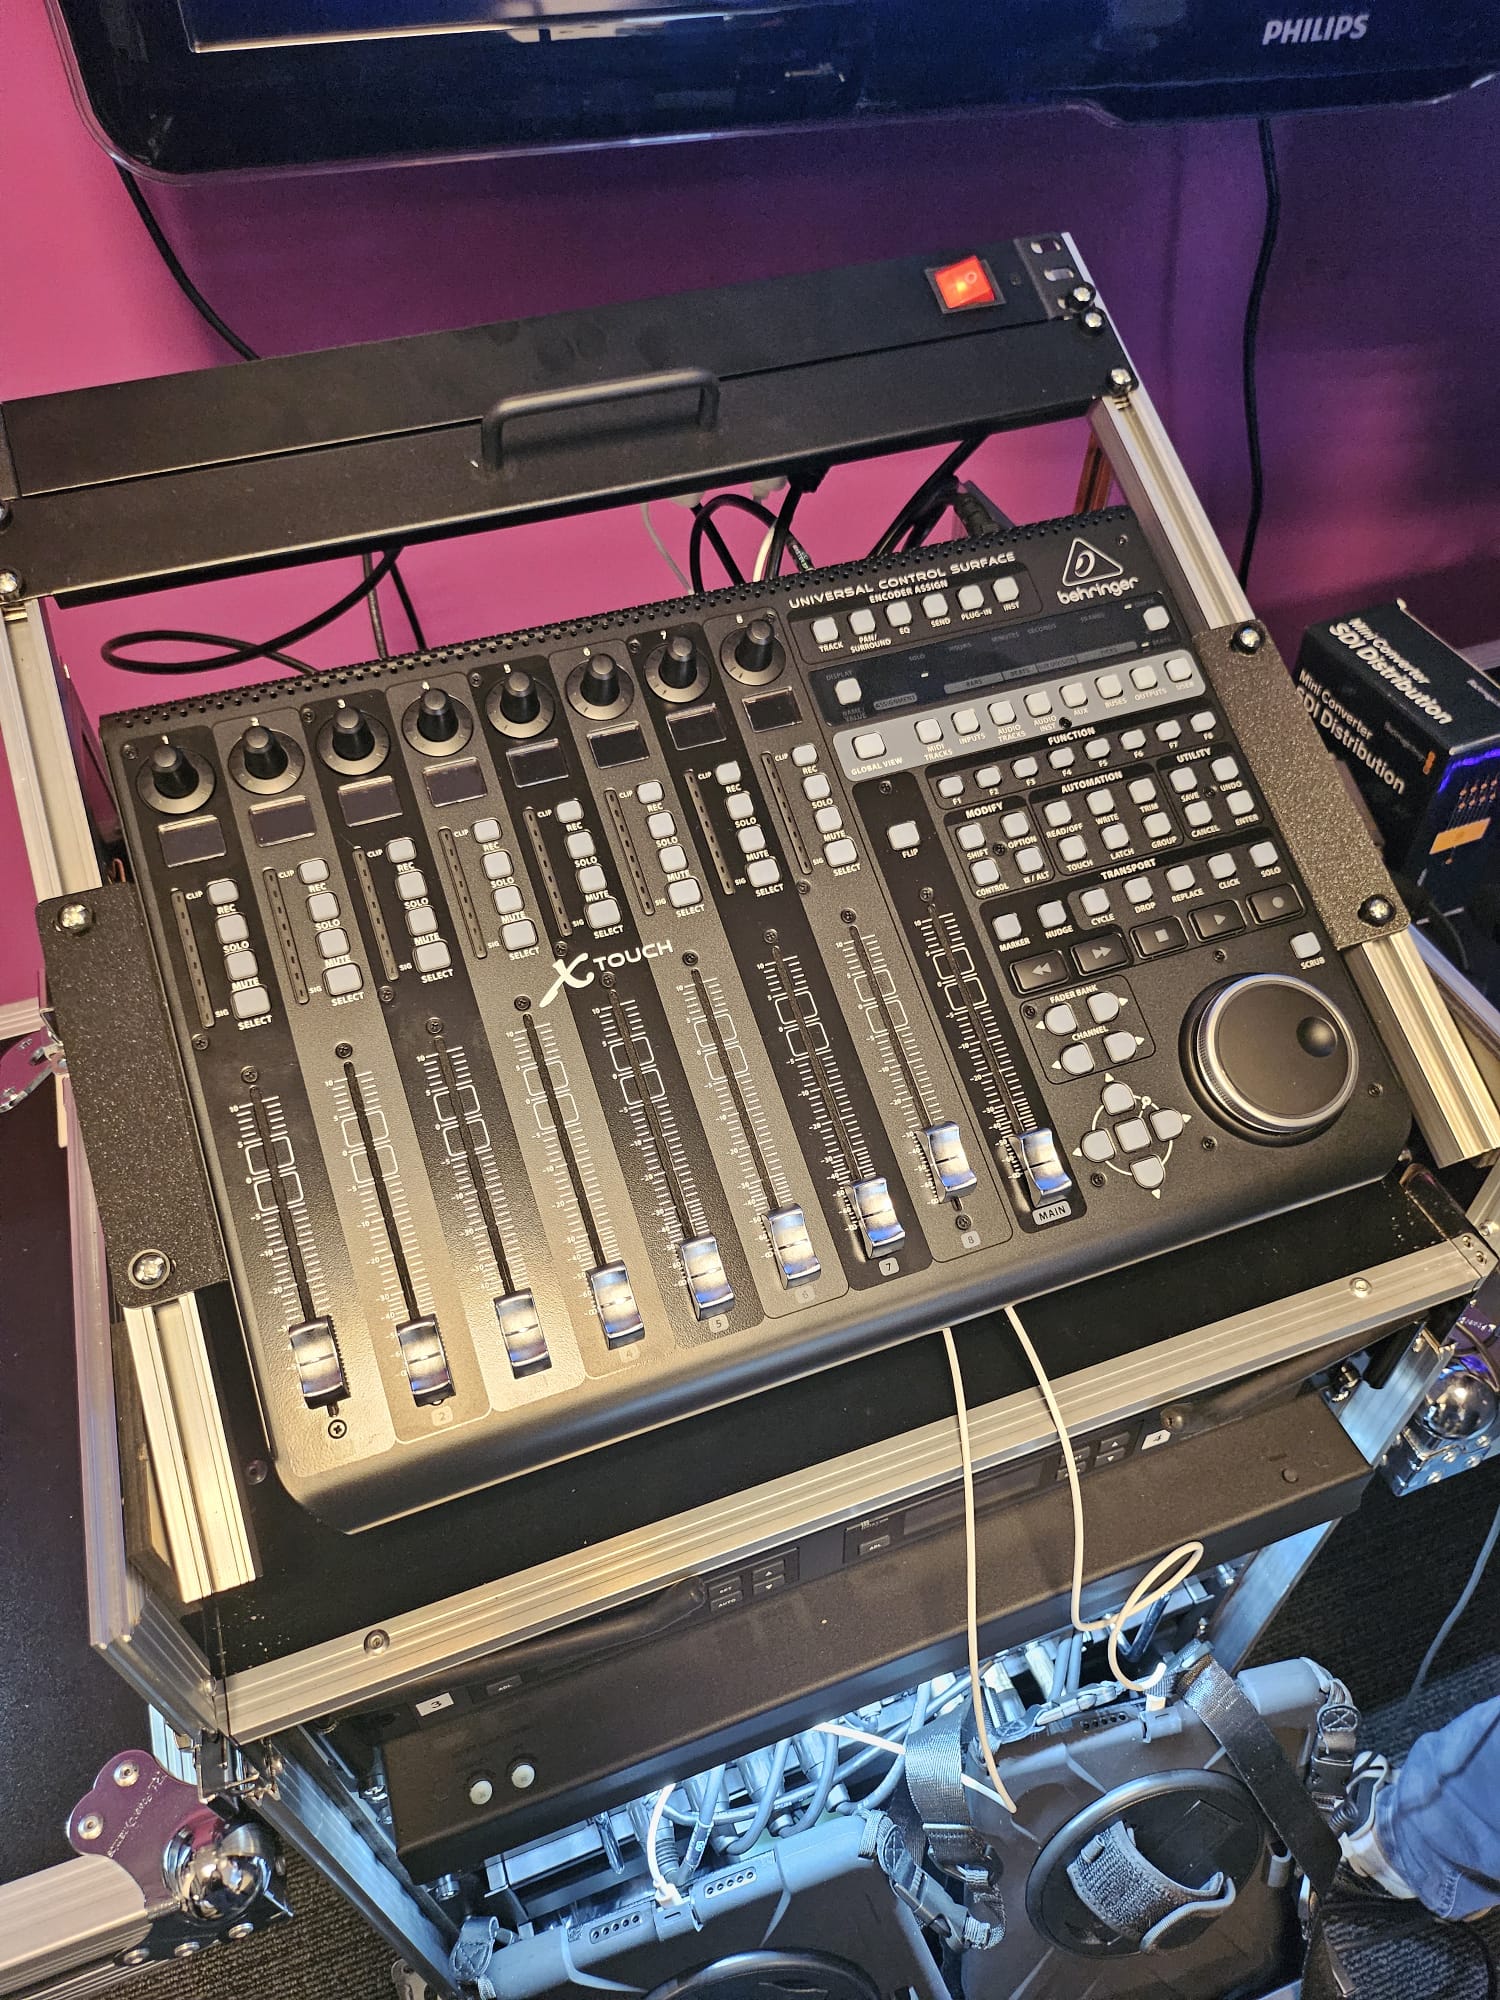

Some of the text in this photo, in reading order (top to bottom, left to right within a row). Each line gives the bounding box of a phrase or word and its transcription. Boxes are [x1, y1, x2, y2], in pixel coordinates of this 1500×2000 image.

[1262, 14, 1369, 45] PHILIPS
[789, 552, 1016, 609] UNIVERSAL CONTROL SURFACE
[869, 579, 948, 603] ENCODER ASSIGN
[1057, 577, 1139, 605] behringer
[1003, 601, 1019, 611] INST
[961, 608, 992, 621] PLUG-IN
[931, 618, 950, 628] SEND
[899, 627, 910, 635] EQ
[859, 634, 878, 644] PAN/
[818, 641, 843, 653] TRACK
[850, 638, 892, 653] SURROUND
[1350, 618, 1431, 684] Mini Converter
[826, 670, 852, 681] DISPLAY
[1329, 622, 1366, 650] SDI
[1357, 648, 1453, 725] Distribution
[1176, 681, 1194, 690] USER
[1135, 688, 1167, 700] OUTPUTS
[1300, 669, 1322, 695] Mini
[1322, 688, 1374, 741] Converter
[1074, 708, 1088, 716] AUX
[1034, 716, 1057, 726] AUDIO
[997, 725, 1021, 736] AUDIO
[1040, 723, 1056, 732] INST
[959, 733, 986, 745] INPUTS
[997, 731, 1026, 742] TRACKS
[1048, 727, 1095, 745] FUNCTION
[927, 744, 944, 753] MIDI
[1169, 741, 1178, 749] F7
[775, 753, 788, 762] CLIP
[924, 749, 953, 761] TRACKS
[1134, 750, 1144, 759] F6
[1176, 748, 1211, 763] UTILITY
[1320, 711, 1405, 795] Distribution
[802, 765, 818, 774] REC
[851, 757, 903, 776] GLOBAL VIEW
[1099, 760, 1108, 768] F5
[698, 771, 712, 780] CLIP
[1062, 769, 1072, 777] F4
[1026, 778, 1036, 786] F3
[1061, 771, 1122, 794] AUTOMATION
[1220, 781, 1242, 792] UNDO
[725, 783, 742, 793] REC
[619, 791, 633, 799] CLIP
[1181, 792, 1200, 802] SAVE
[647, 803, 663, 812] REC
[812, 798, 833, 808] SOLO
[1139, 803, 1159, 813] TRIM
[537, 809, 552, 818] CLIP
[966, 802, 1003, 819] MODIFY
[735, 817, 756, 828] SOLO
[1095, 813, 1119, 825] WRITE
[1235, 814, 1259, 826] ENTER
[566, 822, 583, 831] REC
[1046, 823, 1083, 838] READ/OFF
[1191, 825, 1220, 838] CANCEL
[454, 829, 468, 837] CLIP
[823, 830, 846, 842] MUTE
[483, 841, 500, 851] REC
[656, 837, 678, 848] SOLO
[1008, 835, 1037, 849] OPTION
[1151, 836, 1178, 849] GROUP
[367, 849, 383, 858] CLIP
[746, 850, 770, 862] MUTE
[902, 848, 918, 859] FLIP
[967, 849, 989, 860] SHIFT
[1110, 848, 1134, 860] LATCH
[397, 862, 414, 872] REC
[575, 857, 598, 867] SOLO
[813, 858, 824, 866] SIG
[1066, 860, 1093, 872] TOUCH
[278, 870, 294, 879] CLIP
[833, 863, 861, 877] SELECT
[1101, 858, 1156, 880] TRANSPORT
[1261, 867, 1281, 877] SOLO
[667, 870, 690, 882] MUTE
[308, 882, 327, 892] REC
[491, 877, 515, 888] SOLO
[735, 878, 747, 886] SIG
[1218, 878, 1240, 890] CLICK
[755, 883, 784, 897] SELECT
[976, 882, 1009, 897] CONTROL
[186, 891, 203, 900] CLIP
[585, 890, 610, 902] MUTE
[1171, 888, 1204, 903] REPLACE
[404, 898, 428, 909] SOLO
[655, 898, 667, 906] SIG
[1135, 902, 1156, 913] DROP
[217, 904, 236, 914] REC
[676, 904, 705, 918] SELECT
[501, 911, 526, 923] MUTE
[1091, 913, 1115, 926] CYCLE
[315, 919, 340, 930] SOLO
[572, 919, 584, 927] SIG
[594, 925, 624, 939] SELECT
[1045, 925, 1073, 939] NUDGE
[414, 933, 440, 945] MUTE
[999, 937, 1030, 952] MARKER
[223, 941, 249, 952] SOLO
[488, 941, 499, 949] SIG
[509, 947, 540, 960] SELECT
[324, 955, 351, 968] MUTE
[399, 962, 412, 971] SIG
[1300, 957, 1325, 969] SCRUB
[421, 969, 453, 984] SELECT
[539, 940, 673, 1008] X TOUCH
[232, 977, 260, 989] MUTE
[309, 986, 322, 994] SIG
[1050, 984, 1098, 1003] FADER BANK
[331, 992, 365, 1007] SELECT
[215, 1009, 229, 1017] SIG
[237, 1015, 272, 1030] SELECT
[1072, 1026, 1109, 1041] CHANNEL
[1039, 1205, 1066, 1220] MAIN
[886, 1262, 892, 1271] 7
[715, 1319, 722, 1329] 5
[438, 1412, 447, 1421] 2
